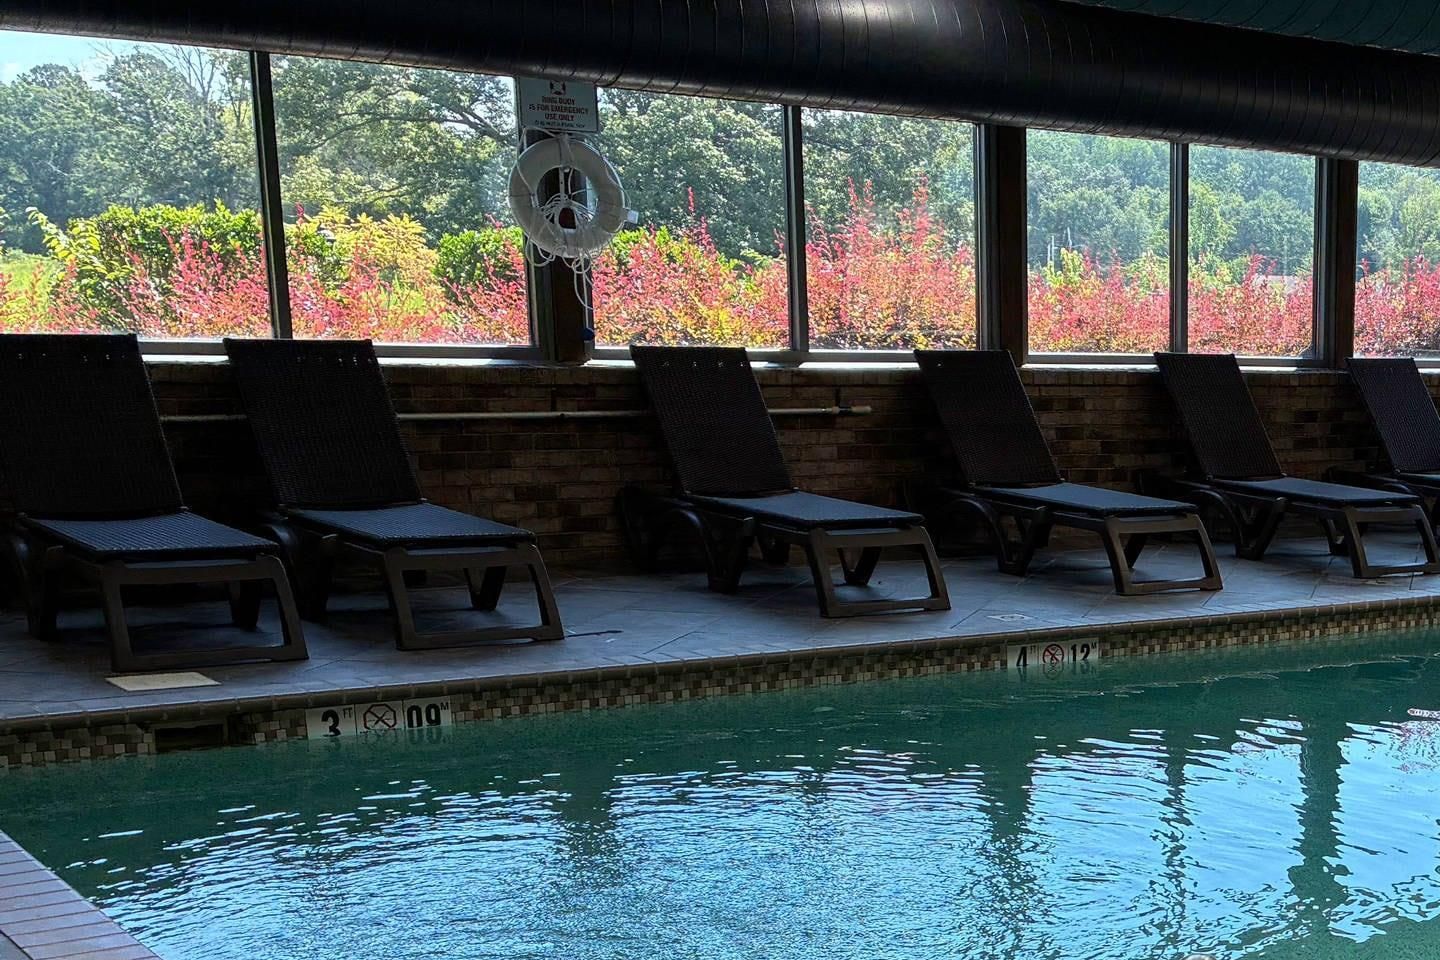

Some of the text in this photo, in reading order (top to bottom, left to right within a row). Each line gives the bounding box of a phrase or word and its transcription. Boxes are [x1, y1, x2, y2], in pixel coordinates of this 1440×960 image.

[537, 104, 550, 112] FOR
[551, 105, 589, 114] EMERGENCY
[545, 113, 575, 122] USE ONLY
